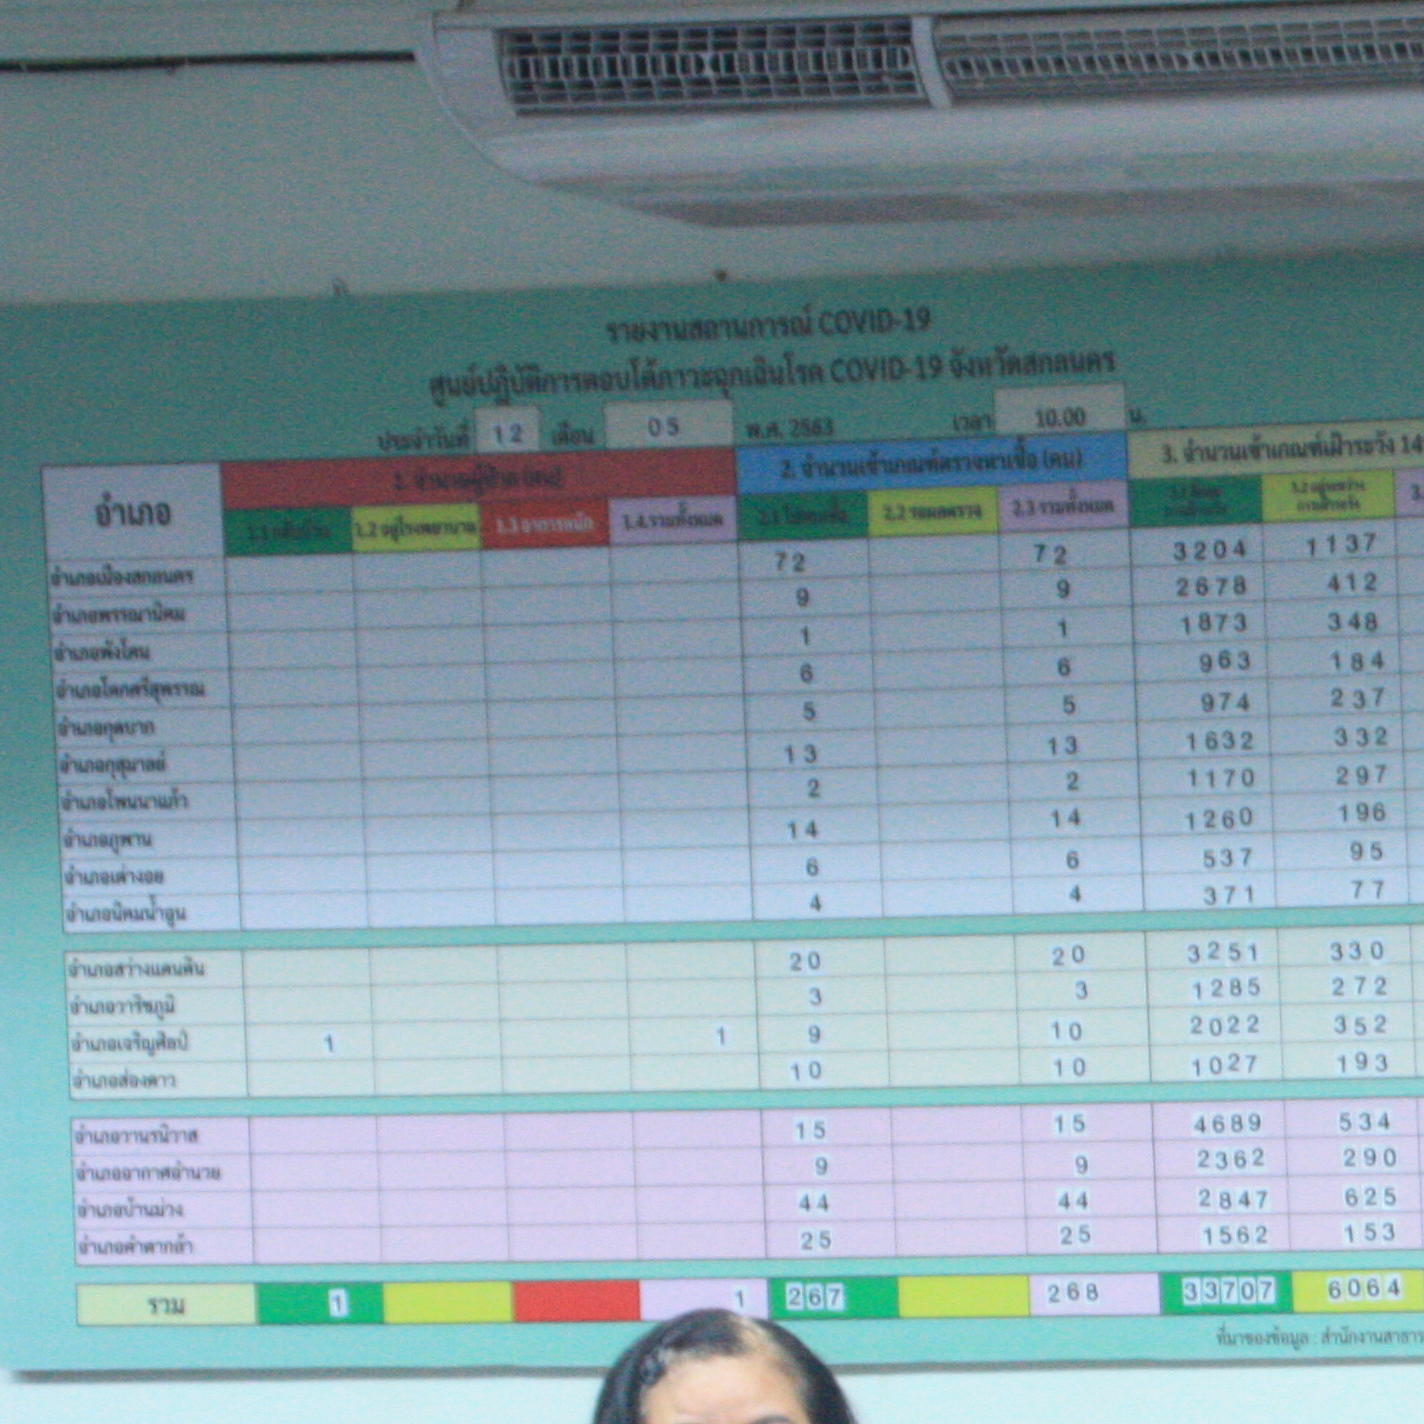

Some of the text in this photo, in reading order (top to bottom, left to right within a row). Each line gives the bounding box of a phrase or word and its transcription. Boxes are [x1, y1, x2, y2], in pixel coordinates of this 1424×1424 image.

[819, 306, 931, 336] COVID-19
[831, 355, 943, 383] COVID-19
[493, 423, 524, 444] 12
[648, 416, 681, 438] 05
[1036, 408, 1087, 428] 10.00
[95, 492, 172, 528] อำเภอ
[775, 551, 805, 573] 72
[1033, 544, 1067, 565] 72
[1174, 538, 1247, 561] 3204
[1307, 532, 1376, 556] 1137
[796, 588, 810, 607] 9
[1056, 579, 1070, 599] 9
[1176, 575, 1247, 597] 2678
[1328, 573, 1377, 592] 412
[802, 627, 810, 645] 1
[1059, 619, 1067, 637] 1
[1182, 614, 1247, 634] 1873
[1328, 612, 1378, 631] 348
[801, 664, 813, 683] 6
[1057, 657, 1071, 676] 6
[1200, 649, 1250, 672] 963
[1332, 650, 1384, 670] 184
[804, 702, 816, 721] 5
[1063, 695, 1076, 714] 5
[1202, 693, 1250, 712] 974
[1331, 687, 1384, 708] 237
[785, 744, 818, 763] 13
[1048, 735, 1078, 755] 13
[1187, 731, 1253, 751] 1632
[1335, 726, 1388, 746] 332
[808, 779, 820, 798] 2
[1067, 772, 1079, 791] 2
[1189, 768, 1254, 787] 1170
[1336, 764, 1387, 784] 297
[787, 820, 819, 838] 14
[1052, 808, 1081, 827] 14
[1188, 807, 1252, 829] 1260
[1339, 803, 1386, 822] 196
[806, 857, 819, 877] 6
[1067, 851, 1079, 870] 6
[1204, 848, 1252, 868] 537
[1350, 842, 1383, 860] 95
[810, 894, 822, 912] 4
[1070, 885, 1081, 902] 4
[1205, 885, 1254, 905] 371
[1352, 880, 1384, 898] 77
[790, 951, 820, 971] 20
[1053, 944, 1085, 966] 20
[1188, 942, 1258, 963] 3251
[1331, 941, 1384, 960] 330
[809, 988, 822, 1005] 3
[1076, 981, 1088, 999] 3
[1194, 978, 1260, 998] 1285
[1332, 976, 1386, 996] 272
[324, 1034, 335, 1053] 1
[716, 1027, 726, 1045] 1
[809, 1025, 821, 1044] 9
[1052, 1022, 1082, 1041] 10
[1190, 1016, 1259, 1036] 2022
[1334, 1015, 1386, 1035] 352
[791, 1061, 822, 1081] 10
[1054, 1058, 1086, 1076] 10
[1192, 1054, 1257, 1076] 1027
[1338, 1052, 1388, 1073] 193
[796, 1121, 826, 1140] 15
[1054, 1114, 1086, 1133] 15
[1195, 1114, 1261, 1134] 4689
[1339, 1112, 1390, 1131] 534
[815, 1157, 829, 1175] 9
[1075, 1156, 1088, 1175] 9
[1198, 1149, 1265, 1169] 2362
[1344, 1147, 1396, 1166] 290
[799, 1193, 830, 1212] 44
[1058, 1191, 1088, 1210] 44
[1200, 1188, 1268, 1210] 2847
[1345, 1188, 1396, 1207] 625
[801, 1230, 831, 1250] 25
[1060, 1225, 1091, 1245] 25
[1203, 1226, 1268, 1245] 1562
[1345, 1223, 1395, 1243] 153
[147, 1296, 187, 1316] รวม
[735, 1290, 745, 1308] 1
[788, 1287, 840, 1308] 267
[1048, 1282, 1099, 1303] 268
[1184, 1280, 1272, 1300] 33707
[1328, 1278, 1401, 1298] 6064
